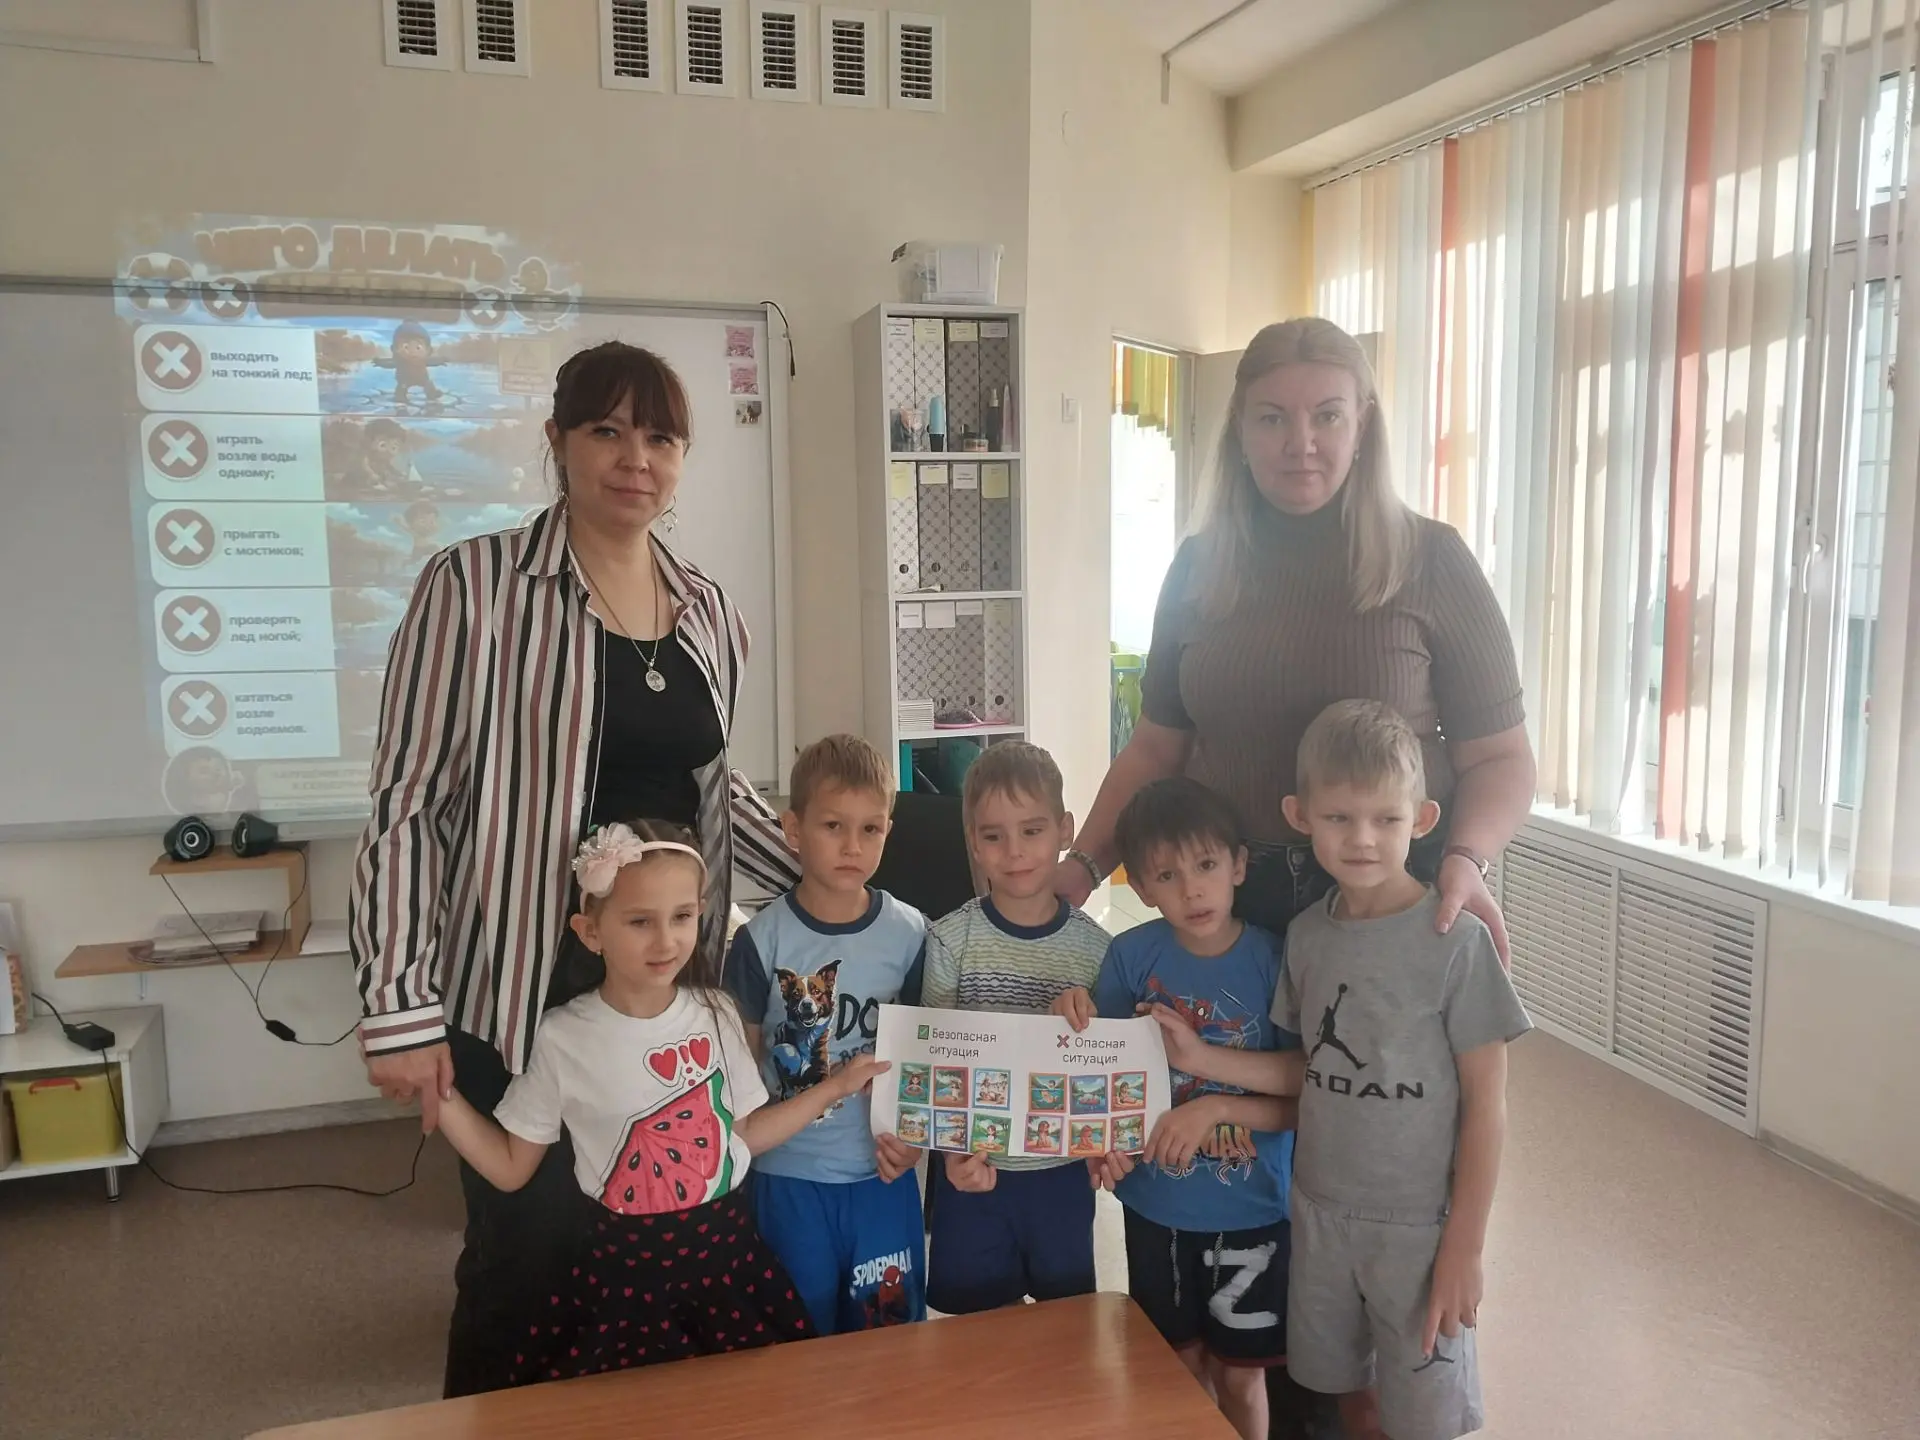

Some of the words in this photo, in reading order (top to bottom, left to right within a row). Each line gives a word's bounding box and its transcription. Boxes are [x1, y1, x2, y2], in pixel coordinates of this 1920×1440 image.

[209, 351, 279, 363] выходить
[211, 368, 228, 379] на
[233, 368, 280, 379] тонкий
[283, 370, 313, 382] лед;
[216, 435, 263, 447] играть
[217, 452, 257, 462] возле
[261, 452, 297, 463] воды
[218, 468, 275, 480] одному;
[222, 530, 280, 541] прыгать
[223, 547, 232, 556] с
[235, 547, 304, 557] мостиков;
[228, 616, 301, 627] проверять
[230, 633, 256, 643] лед
[258, 631, 302, 642] ногой;
[234, 693, 293, 703] кататься
[236, 710, 275, 719] возле
[835, 993, 894, 1041] DO
[932, 1028, 997, 1043] Безопасная
[1075, 1037, 1126, 1049] Опасная
[929, 1044, 979, 1058] ситуация
[1062, 1052, 1118, 1066] ситуация
[1203, 1240, 1279, 1330] Z
